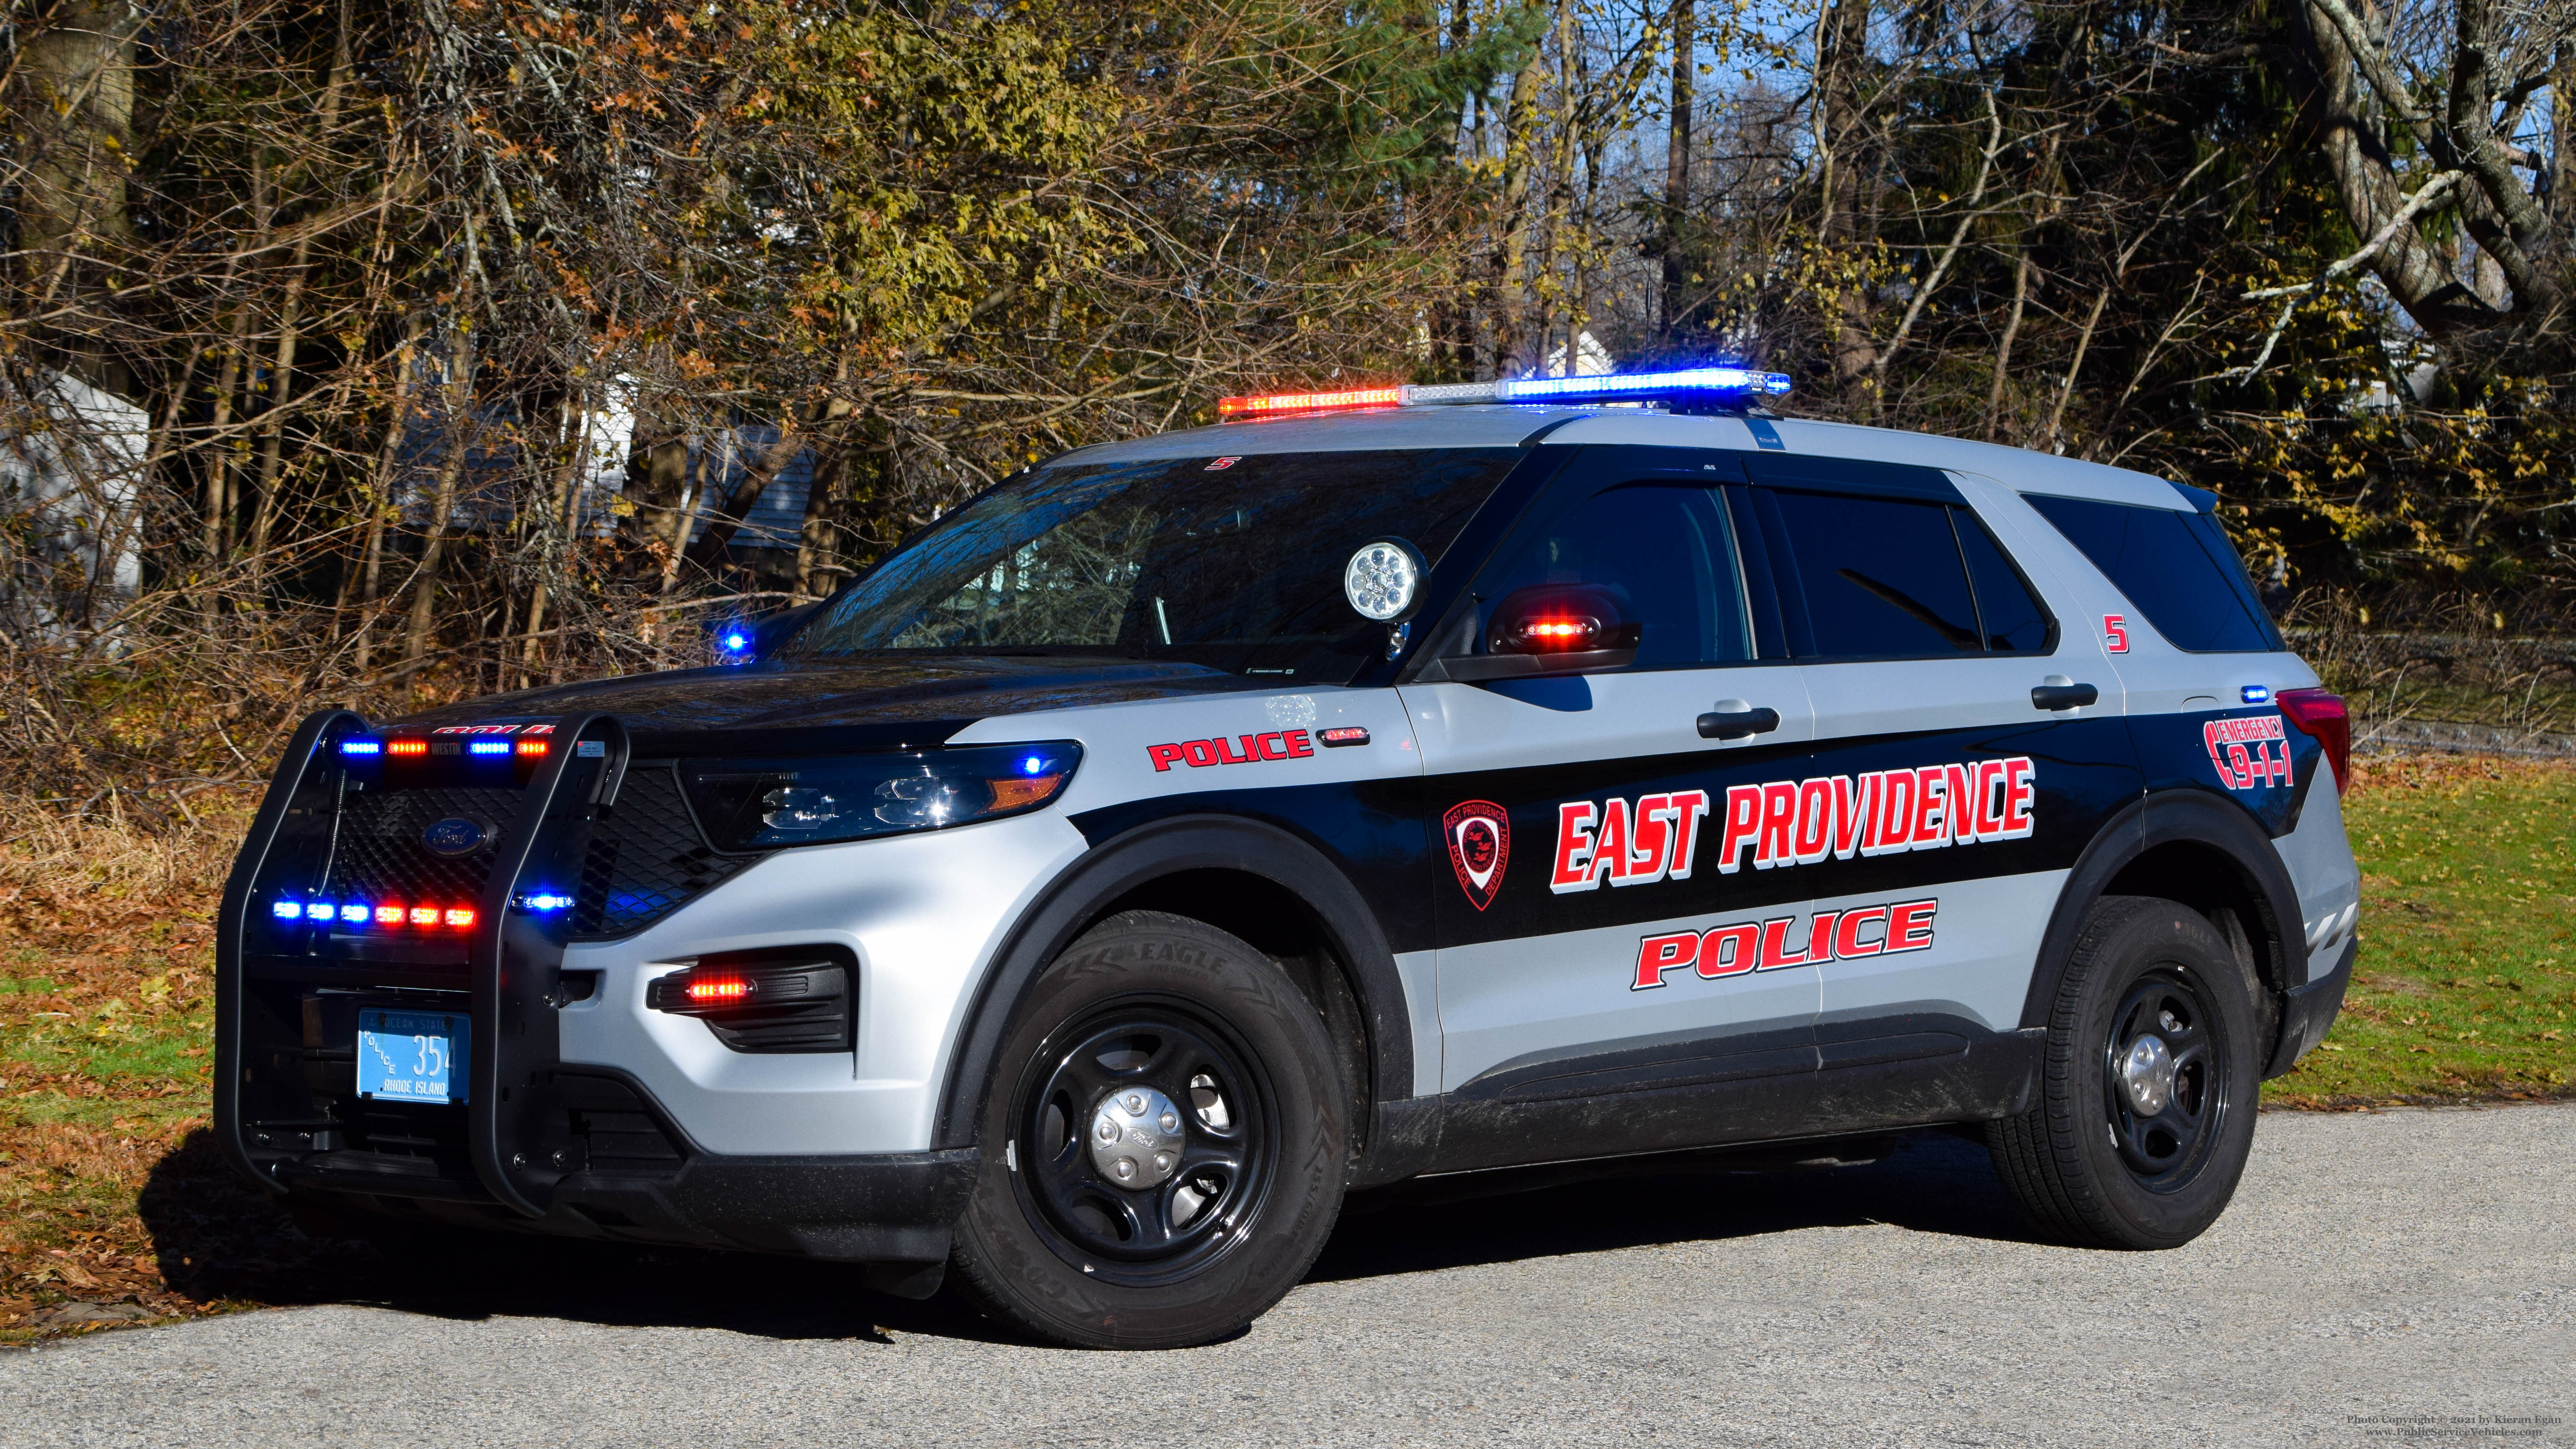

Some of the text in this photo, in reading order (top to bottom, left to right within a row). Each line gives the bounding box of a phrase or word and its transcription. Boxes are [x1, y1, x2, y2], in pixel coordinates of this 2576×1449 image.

[1204, 456, 1242, 471] 5
[2103, 614, 2130, 654] 5
[2215, 715, 2285, 744] EMERGENCY
[1146, 729, 1314, 772] POLICE
[2227, 740, 2293, 789] 9-1-1
[433, 824, 469, 845] Ford
[1446, 804, 1505, 829] EAST PROVIDENCE
[1464, 821, 1493, 843] RHODE ISLAND
[1550, 756, 2035, 894] EAST PROVIDENCE
[1452, 845, 1472, 888] POLICE
[1485, 826, 1507, 896] DEPARTMENT
[1139, 942, 1229, 974] EAGLE
[1630, 897, 1938, 992] POLICE
[385, 1018, 447, 1032] OCEAN STATE
[364, 1031, 395, 1075] POLICE
[413, 1034, 456, 1079] 354
[384, 1079, 445, 1096] RHODE ISLAND
[1132, 1130, 1154, 1148] Ford
